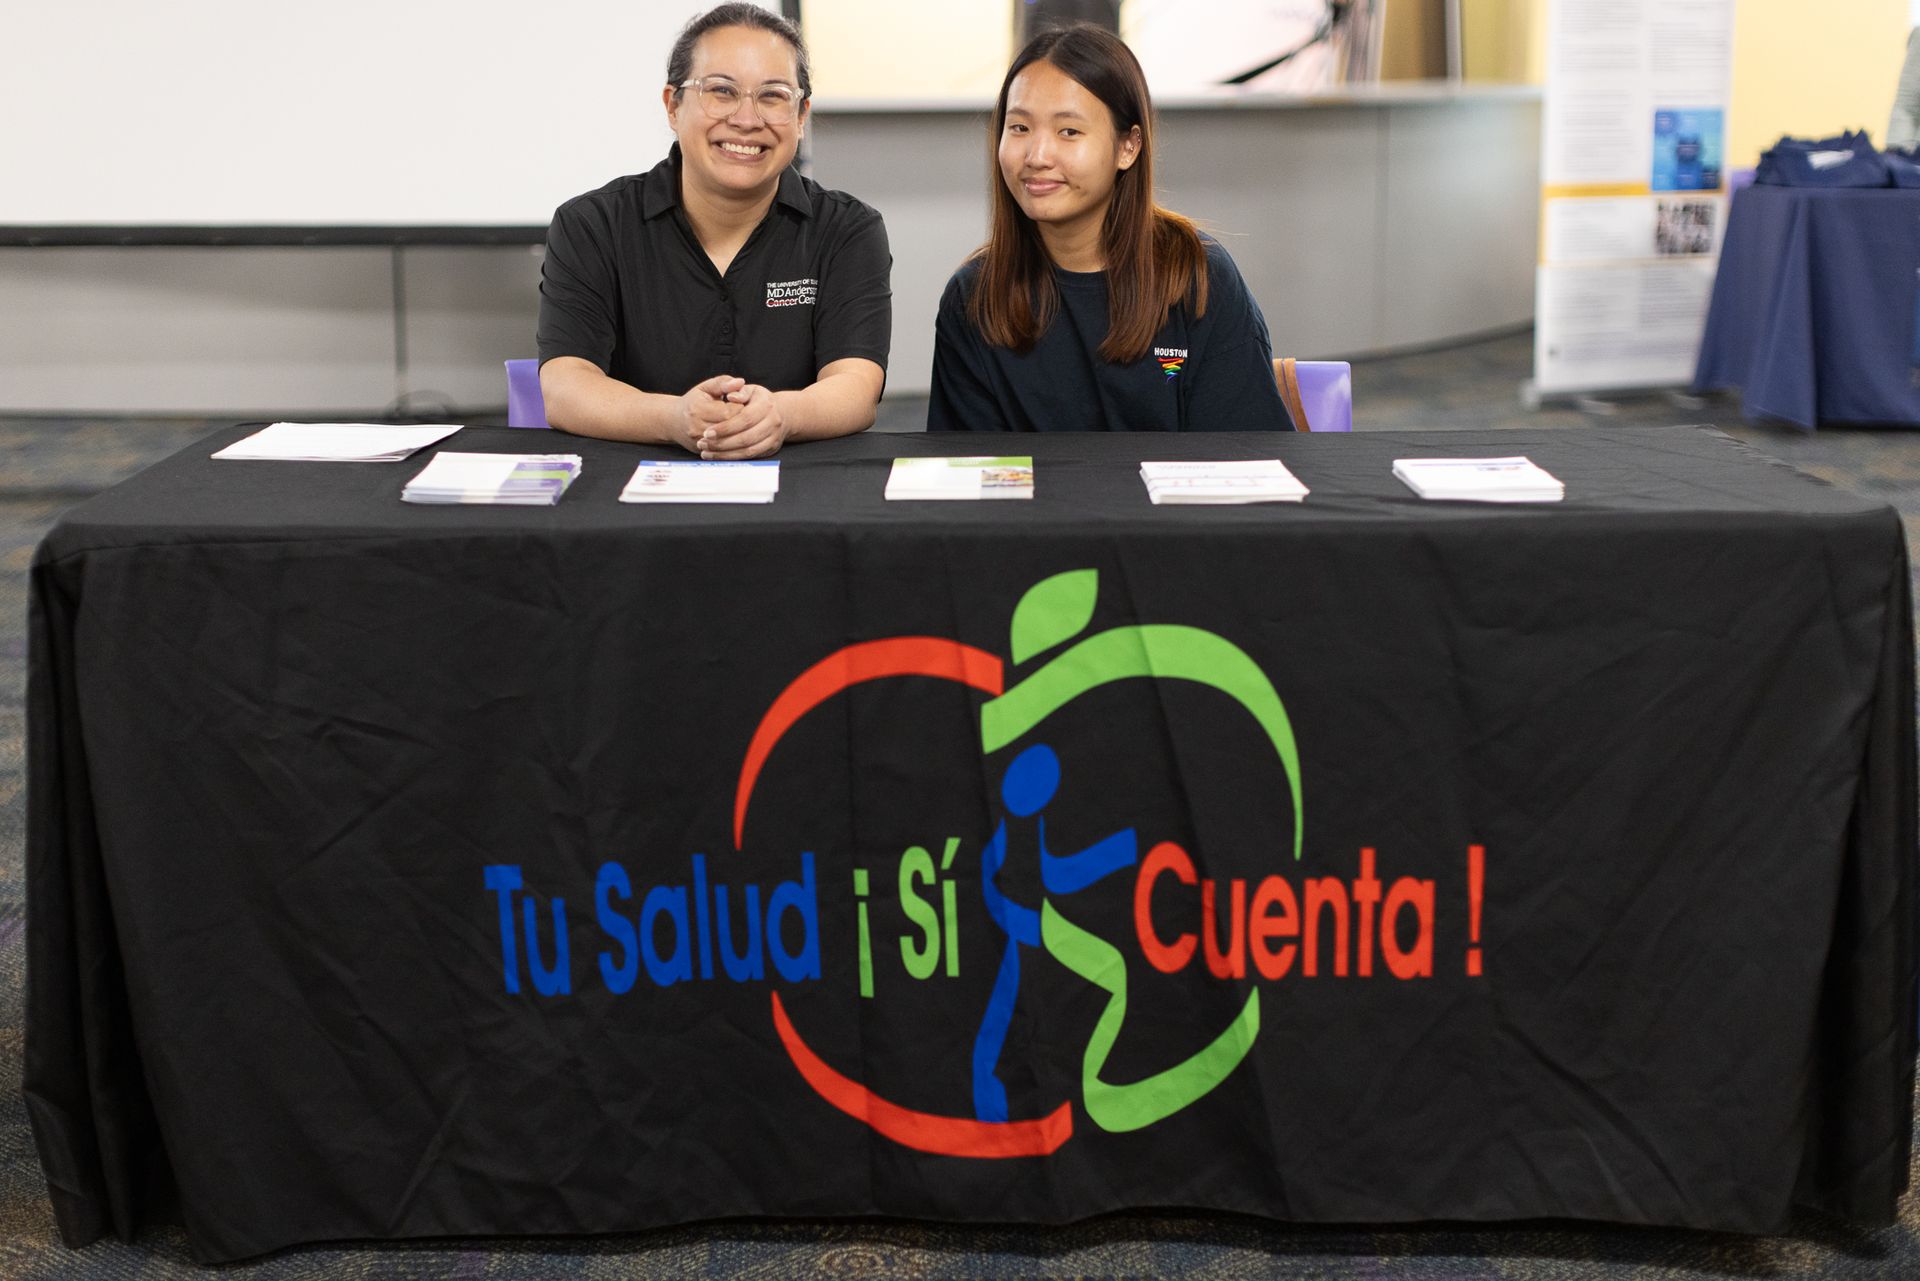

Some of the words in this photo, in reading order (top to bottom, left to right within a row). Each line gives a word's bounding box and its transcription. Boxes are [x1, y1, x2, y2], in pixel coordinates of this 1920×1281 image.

[767, 289, 784, 297] MD
[766, 298, 798, 307] Cancer
[1154, 347, 1188, 358] HOUSTON
[484, 865, 571, 996] Tu
[595, 852, 820, 994] Salud
[900, 838, 960, 979] Sí
[1134, 841, 1435, 980] Cuenta
